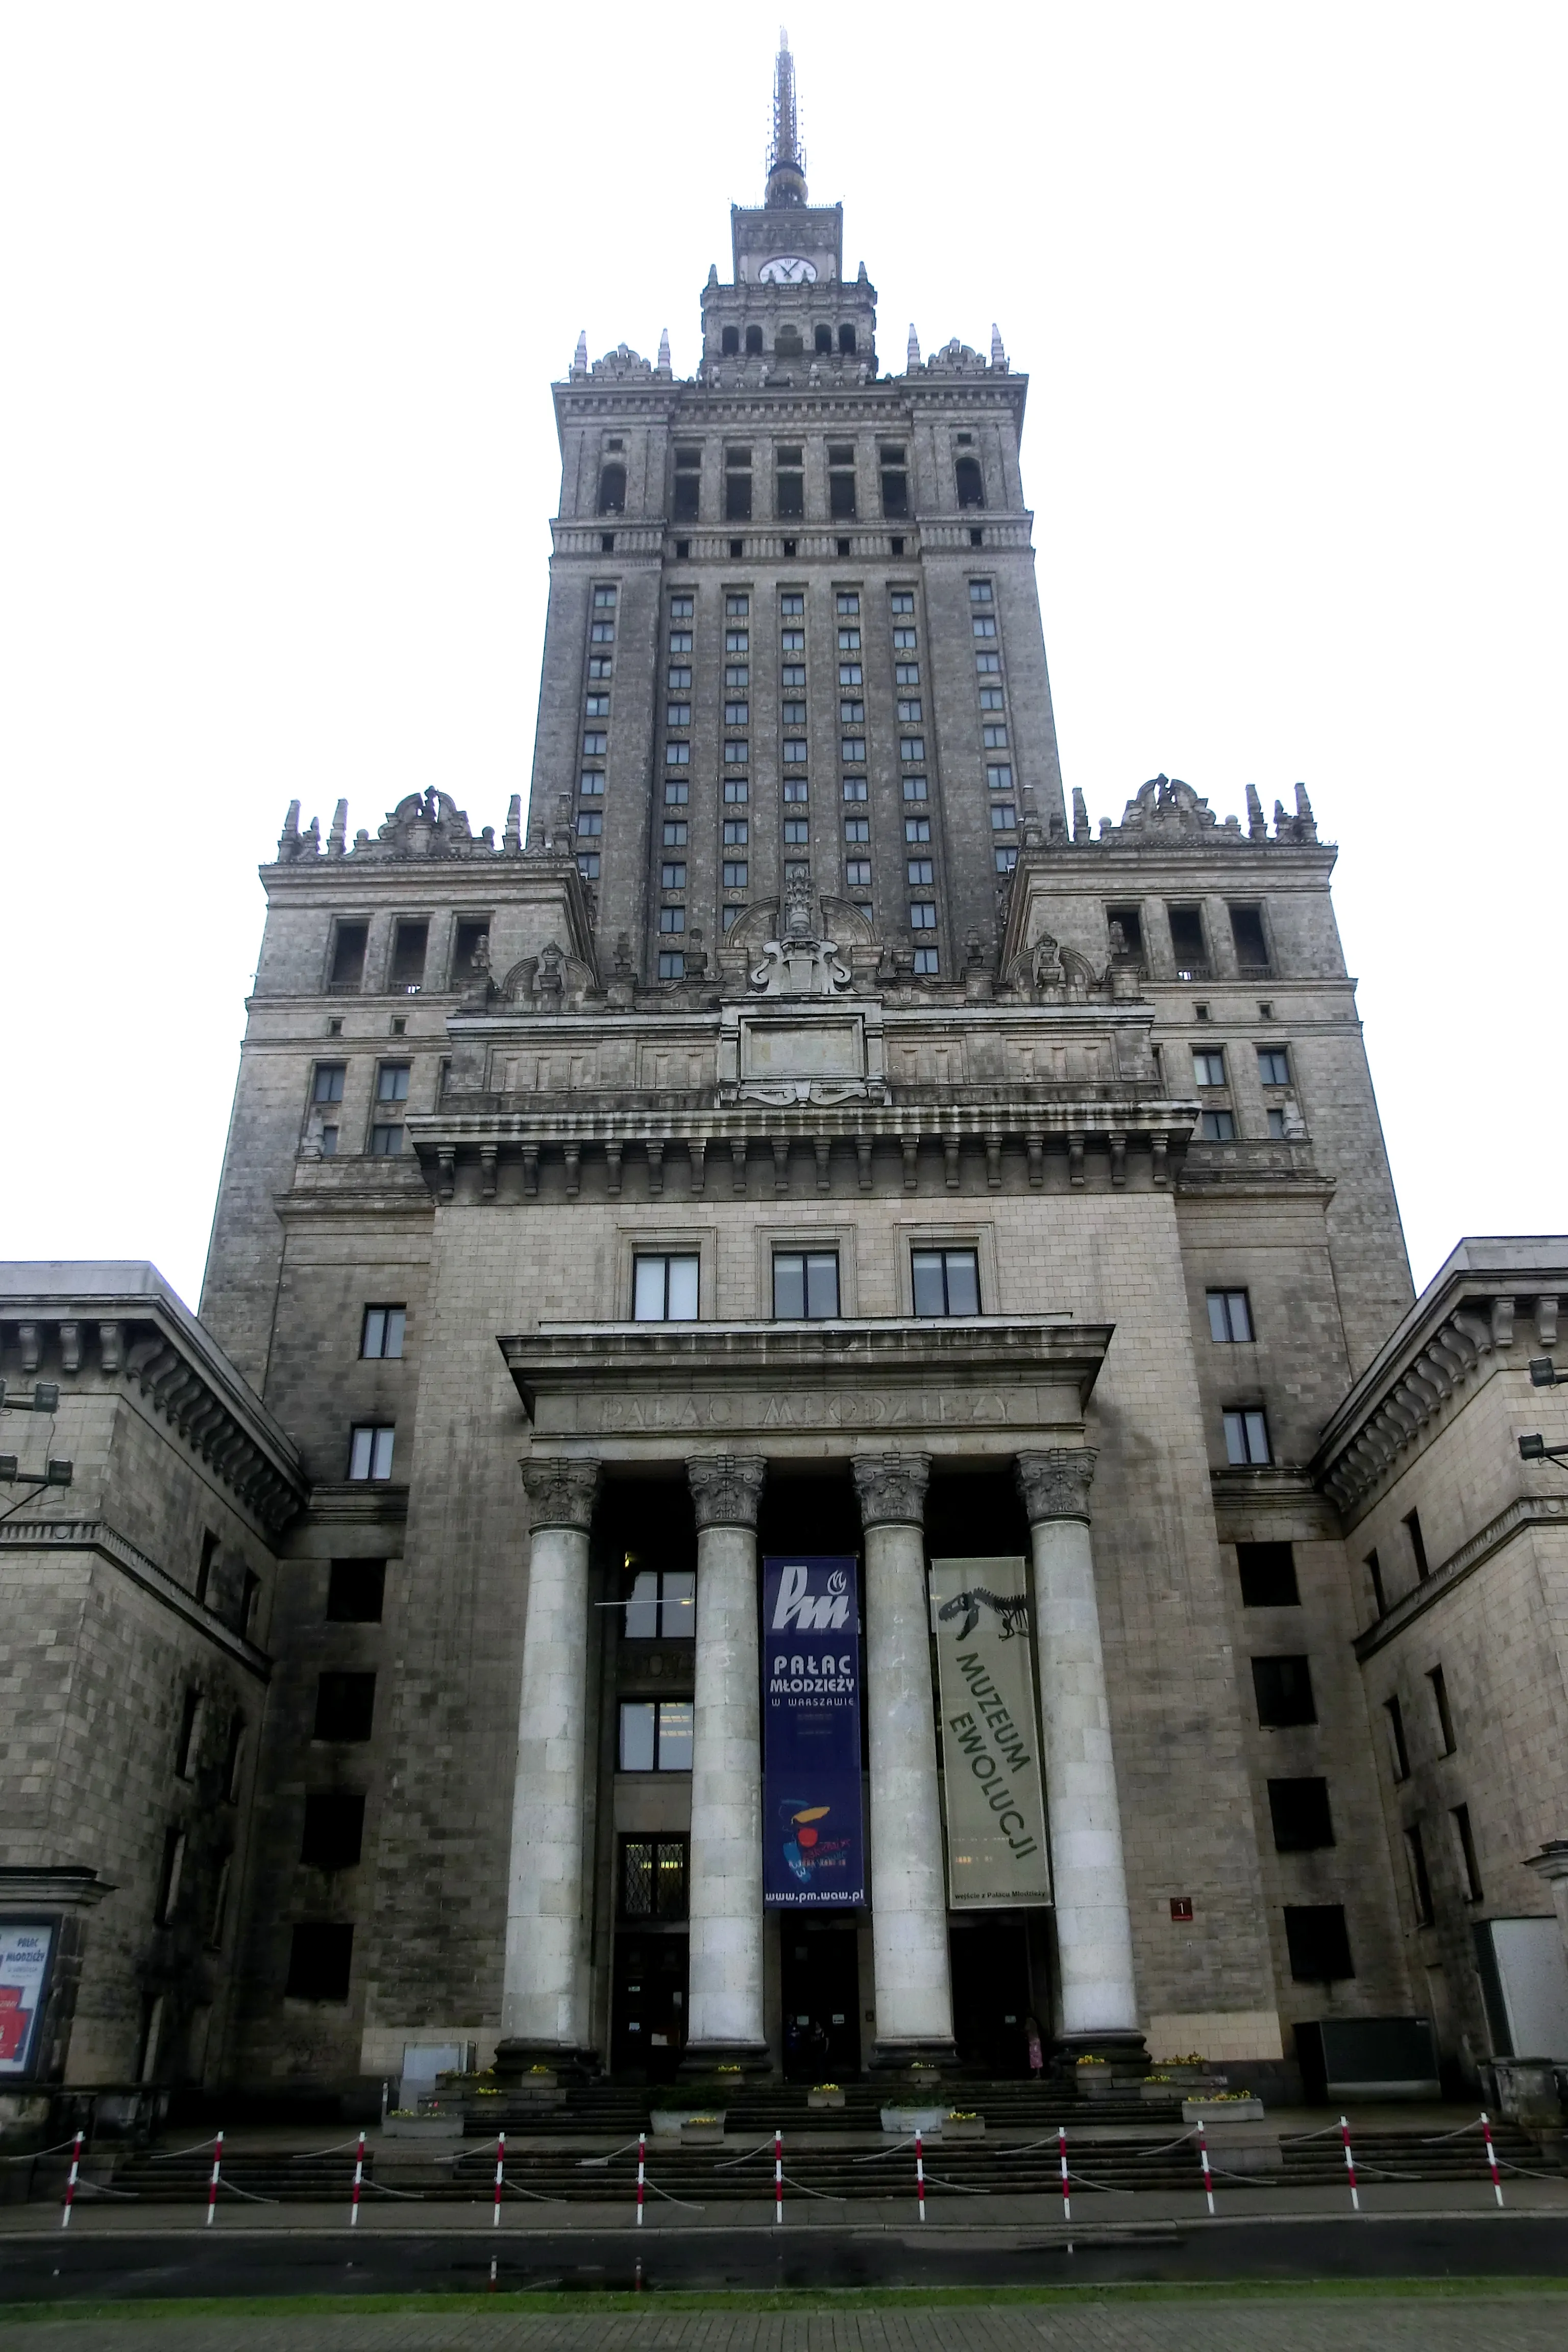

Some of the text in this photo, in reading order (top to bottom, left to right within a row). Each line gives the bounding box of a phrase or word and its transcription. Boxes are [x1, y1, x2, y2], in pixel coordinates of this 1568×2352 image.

[600, 1398, 732, 1426] PAŁAC
[774, 1655, 851, 1675] PAŁAC
[770, 1675, 855, 1693] MŁODZIEŻY
[788, 1697, 854, 1706] WARSZAWIE
[955, 1652, 1031, 1774] MUZEUM
[949, 1711, 1038, 1859] EWOLUCJI
[766, 1889, 864, 1903] www.pm.waw.pl
[1178, 1902, 1184, 1915] 1
